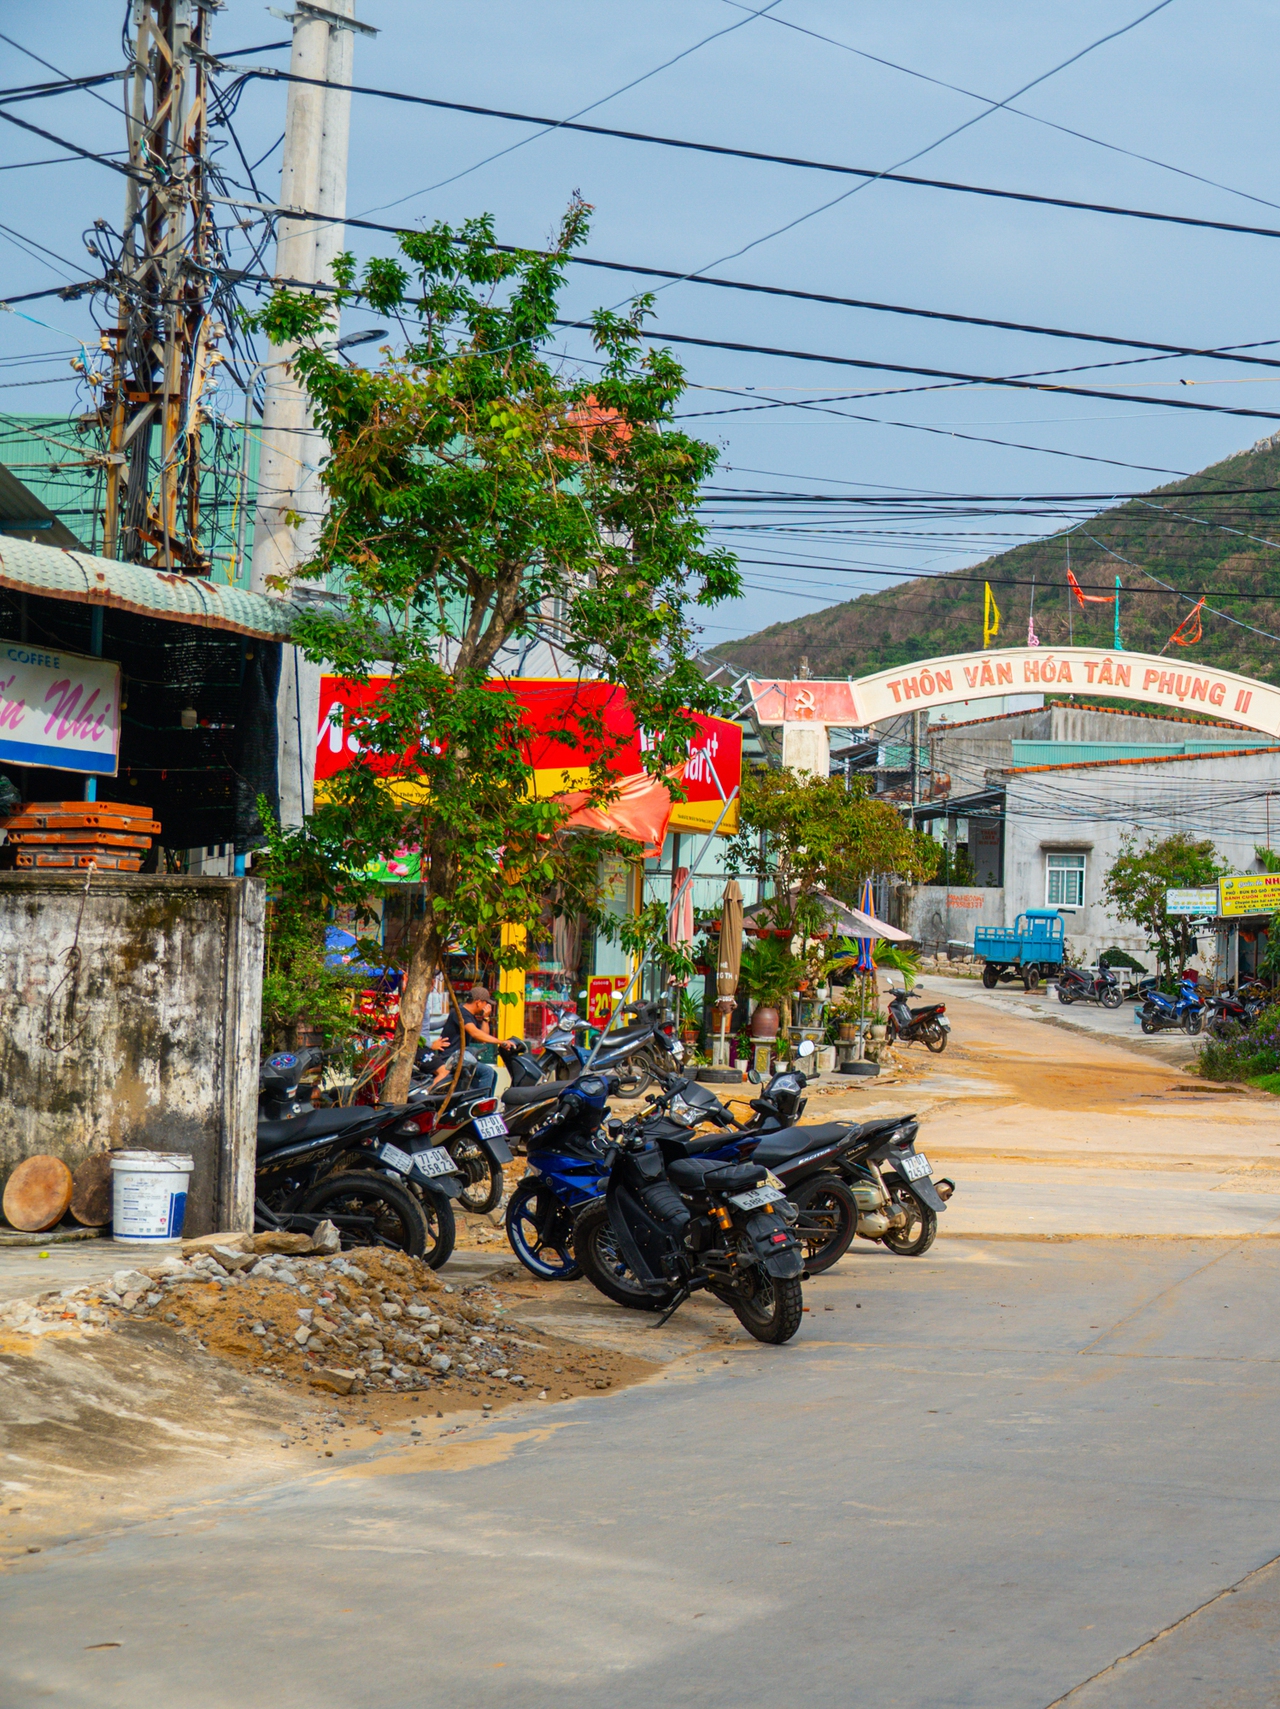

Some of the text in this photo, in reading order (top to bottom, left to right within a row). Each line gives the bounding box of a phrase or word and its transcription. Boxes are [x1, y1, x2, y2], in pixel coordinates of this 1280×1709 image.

[7, 649, 60, 669] COFFEE
[887, 655, 1253, 714] THÔN VĂN HÓA TÂN PHỤNG II
[44, 679, 112, 742] Nhi
[418, 1150, 444, 1165] 77-D1
[421, 1160, 455, 1175] 558.23
